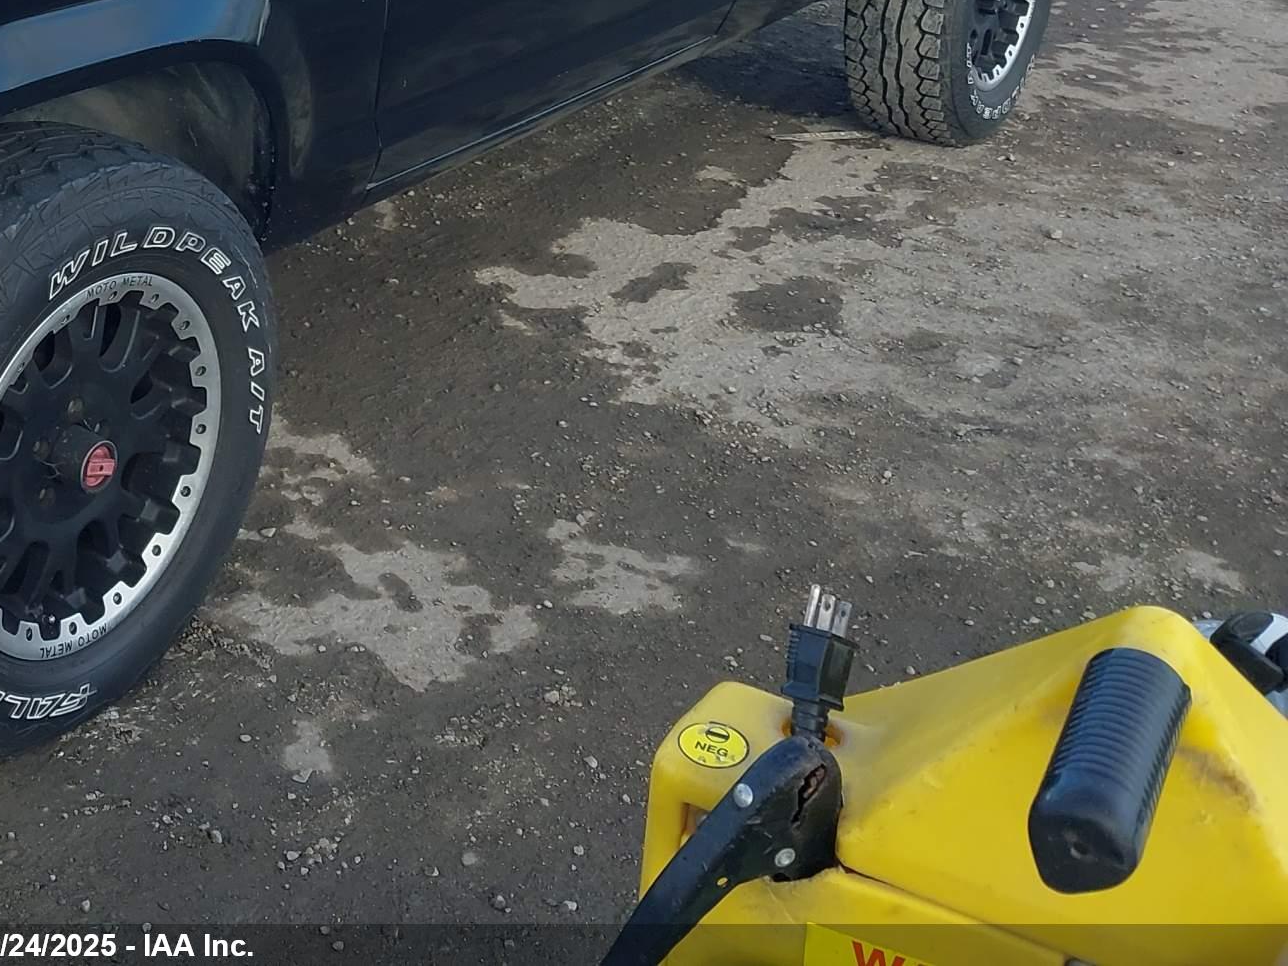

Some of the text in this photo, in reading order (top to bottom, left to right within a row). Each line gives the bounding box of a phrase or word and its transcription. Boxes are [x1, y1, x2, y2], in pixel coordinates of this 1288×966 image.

[48, 226, 260, 333] WILDPEAK
[86, 275, 154, 300] MOTO METAL
[39, 622, 107, 659] MOTO METAL
[694, 740, 729, 758] NEG
